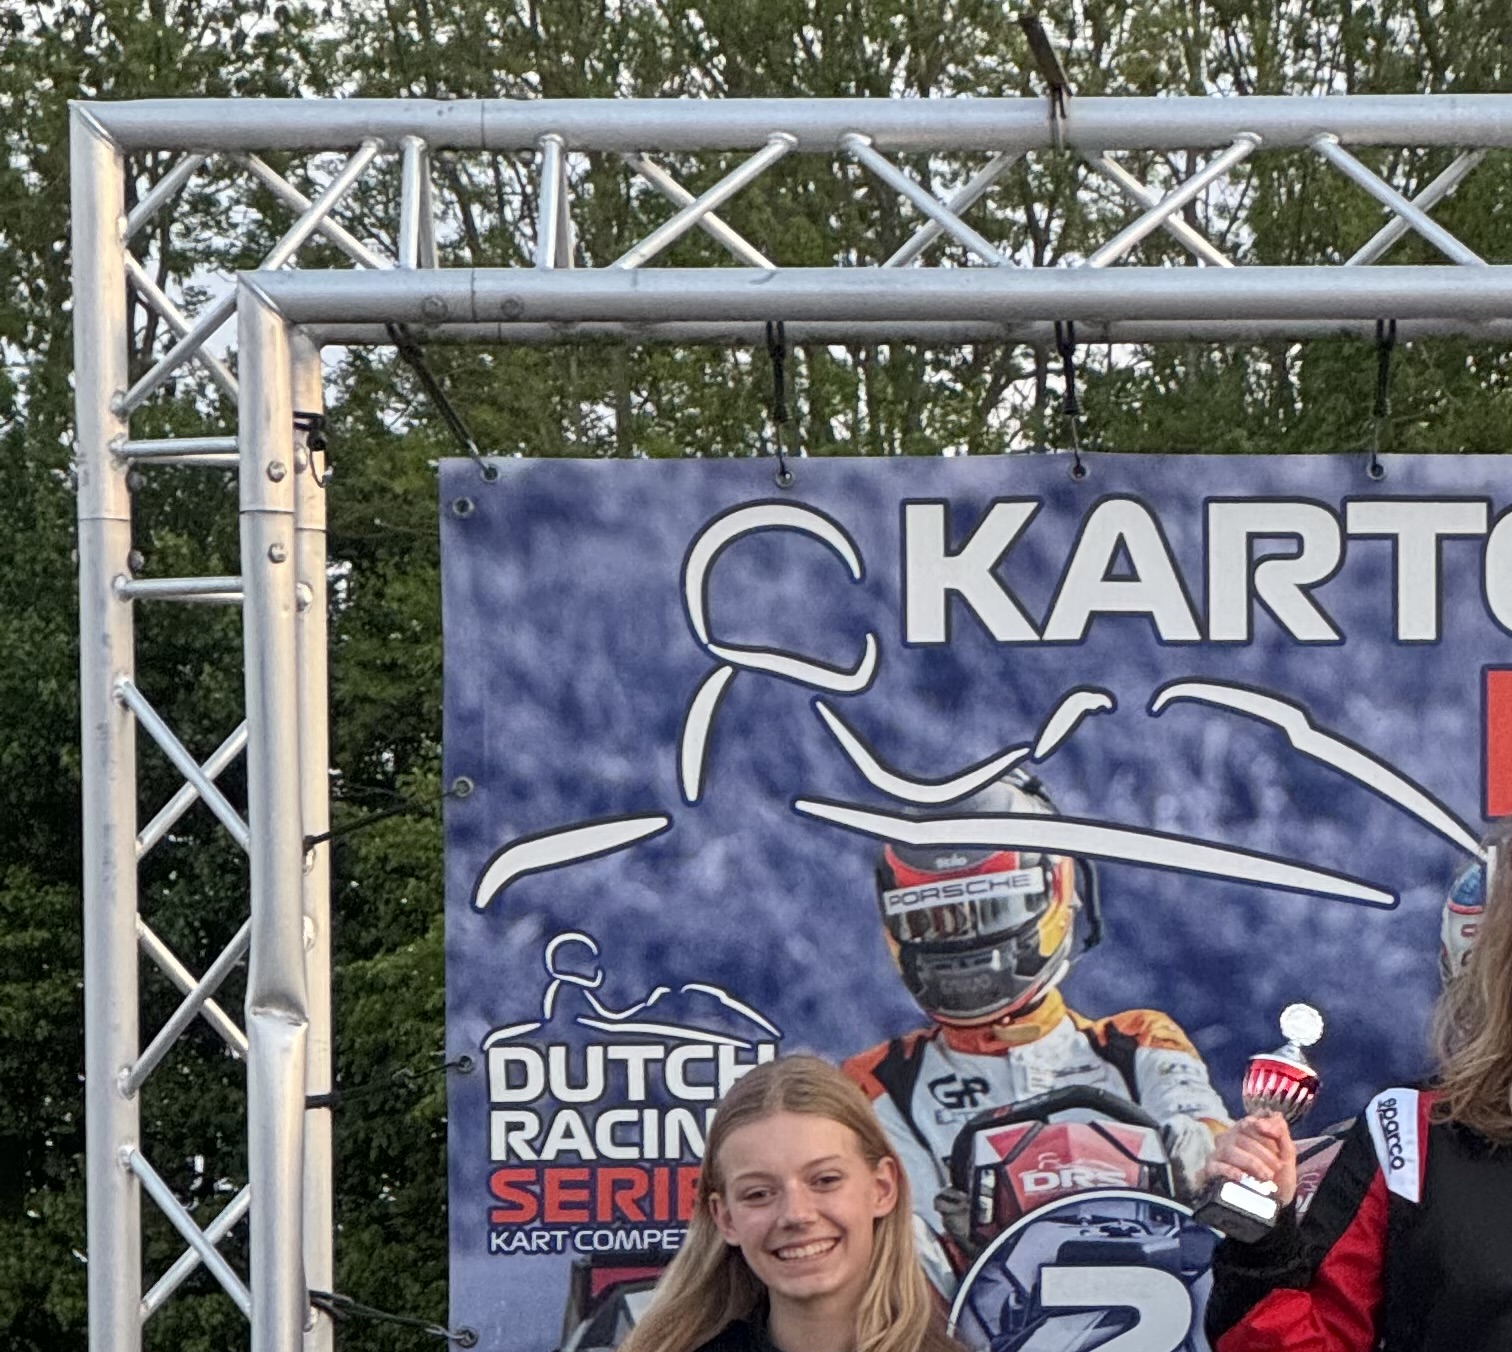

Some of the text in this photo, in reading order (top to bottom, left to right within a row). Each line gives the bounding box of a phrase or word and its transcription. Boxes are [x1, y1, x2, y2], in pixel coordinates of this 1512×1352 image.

[888, 873, 1032, 907] PORSCHE
[489, 1108, 718, 1161] RACIN
[1377, 1097, 1406, 1172] sparco
[489, 1167, 700, 1224] SERIE
[490, 1229, 688, 1252] KART COMPE
